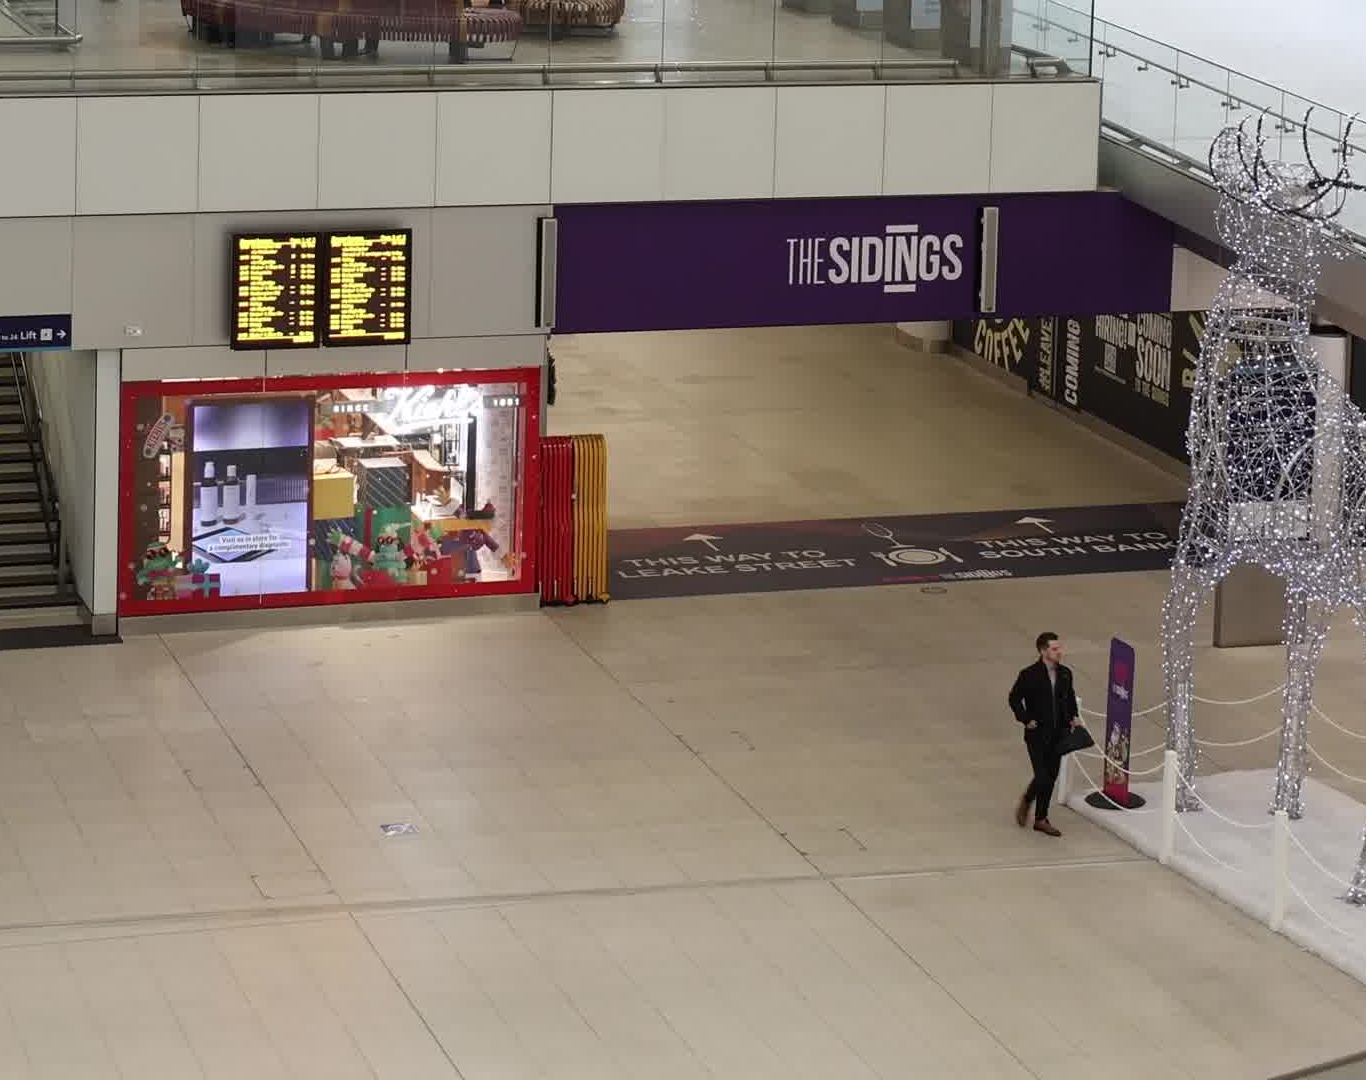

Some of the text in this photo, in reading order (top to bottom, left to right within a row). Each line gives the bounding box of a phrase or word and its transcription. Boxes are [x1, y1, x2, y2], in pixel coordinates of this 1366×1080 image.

[786, 233, 964, 286] THE SIDINGS
[20, 330, 37, 341] Lift
[1136, 312, 1172, 349] COMING
[1063, 318, 1082, 407] COMING
[1135, 336, 1172, 392] SOON
[975, 531, 1168, 549] THIS WAY TO
[978, 539, 1181, 560] SOUTH BANK
[618, 558, 857, 579] LEAKE STREET
[621, 549, 827, 568] THIS WAY TO
